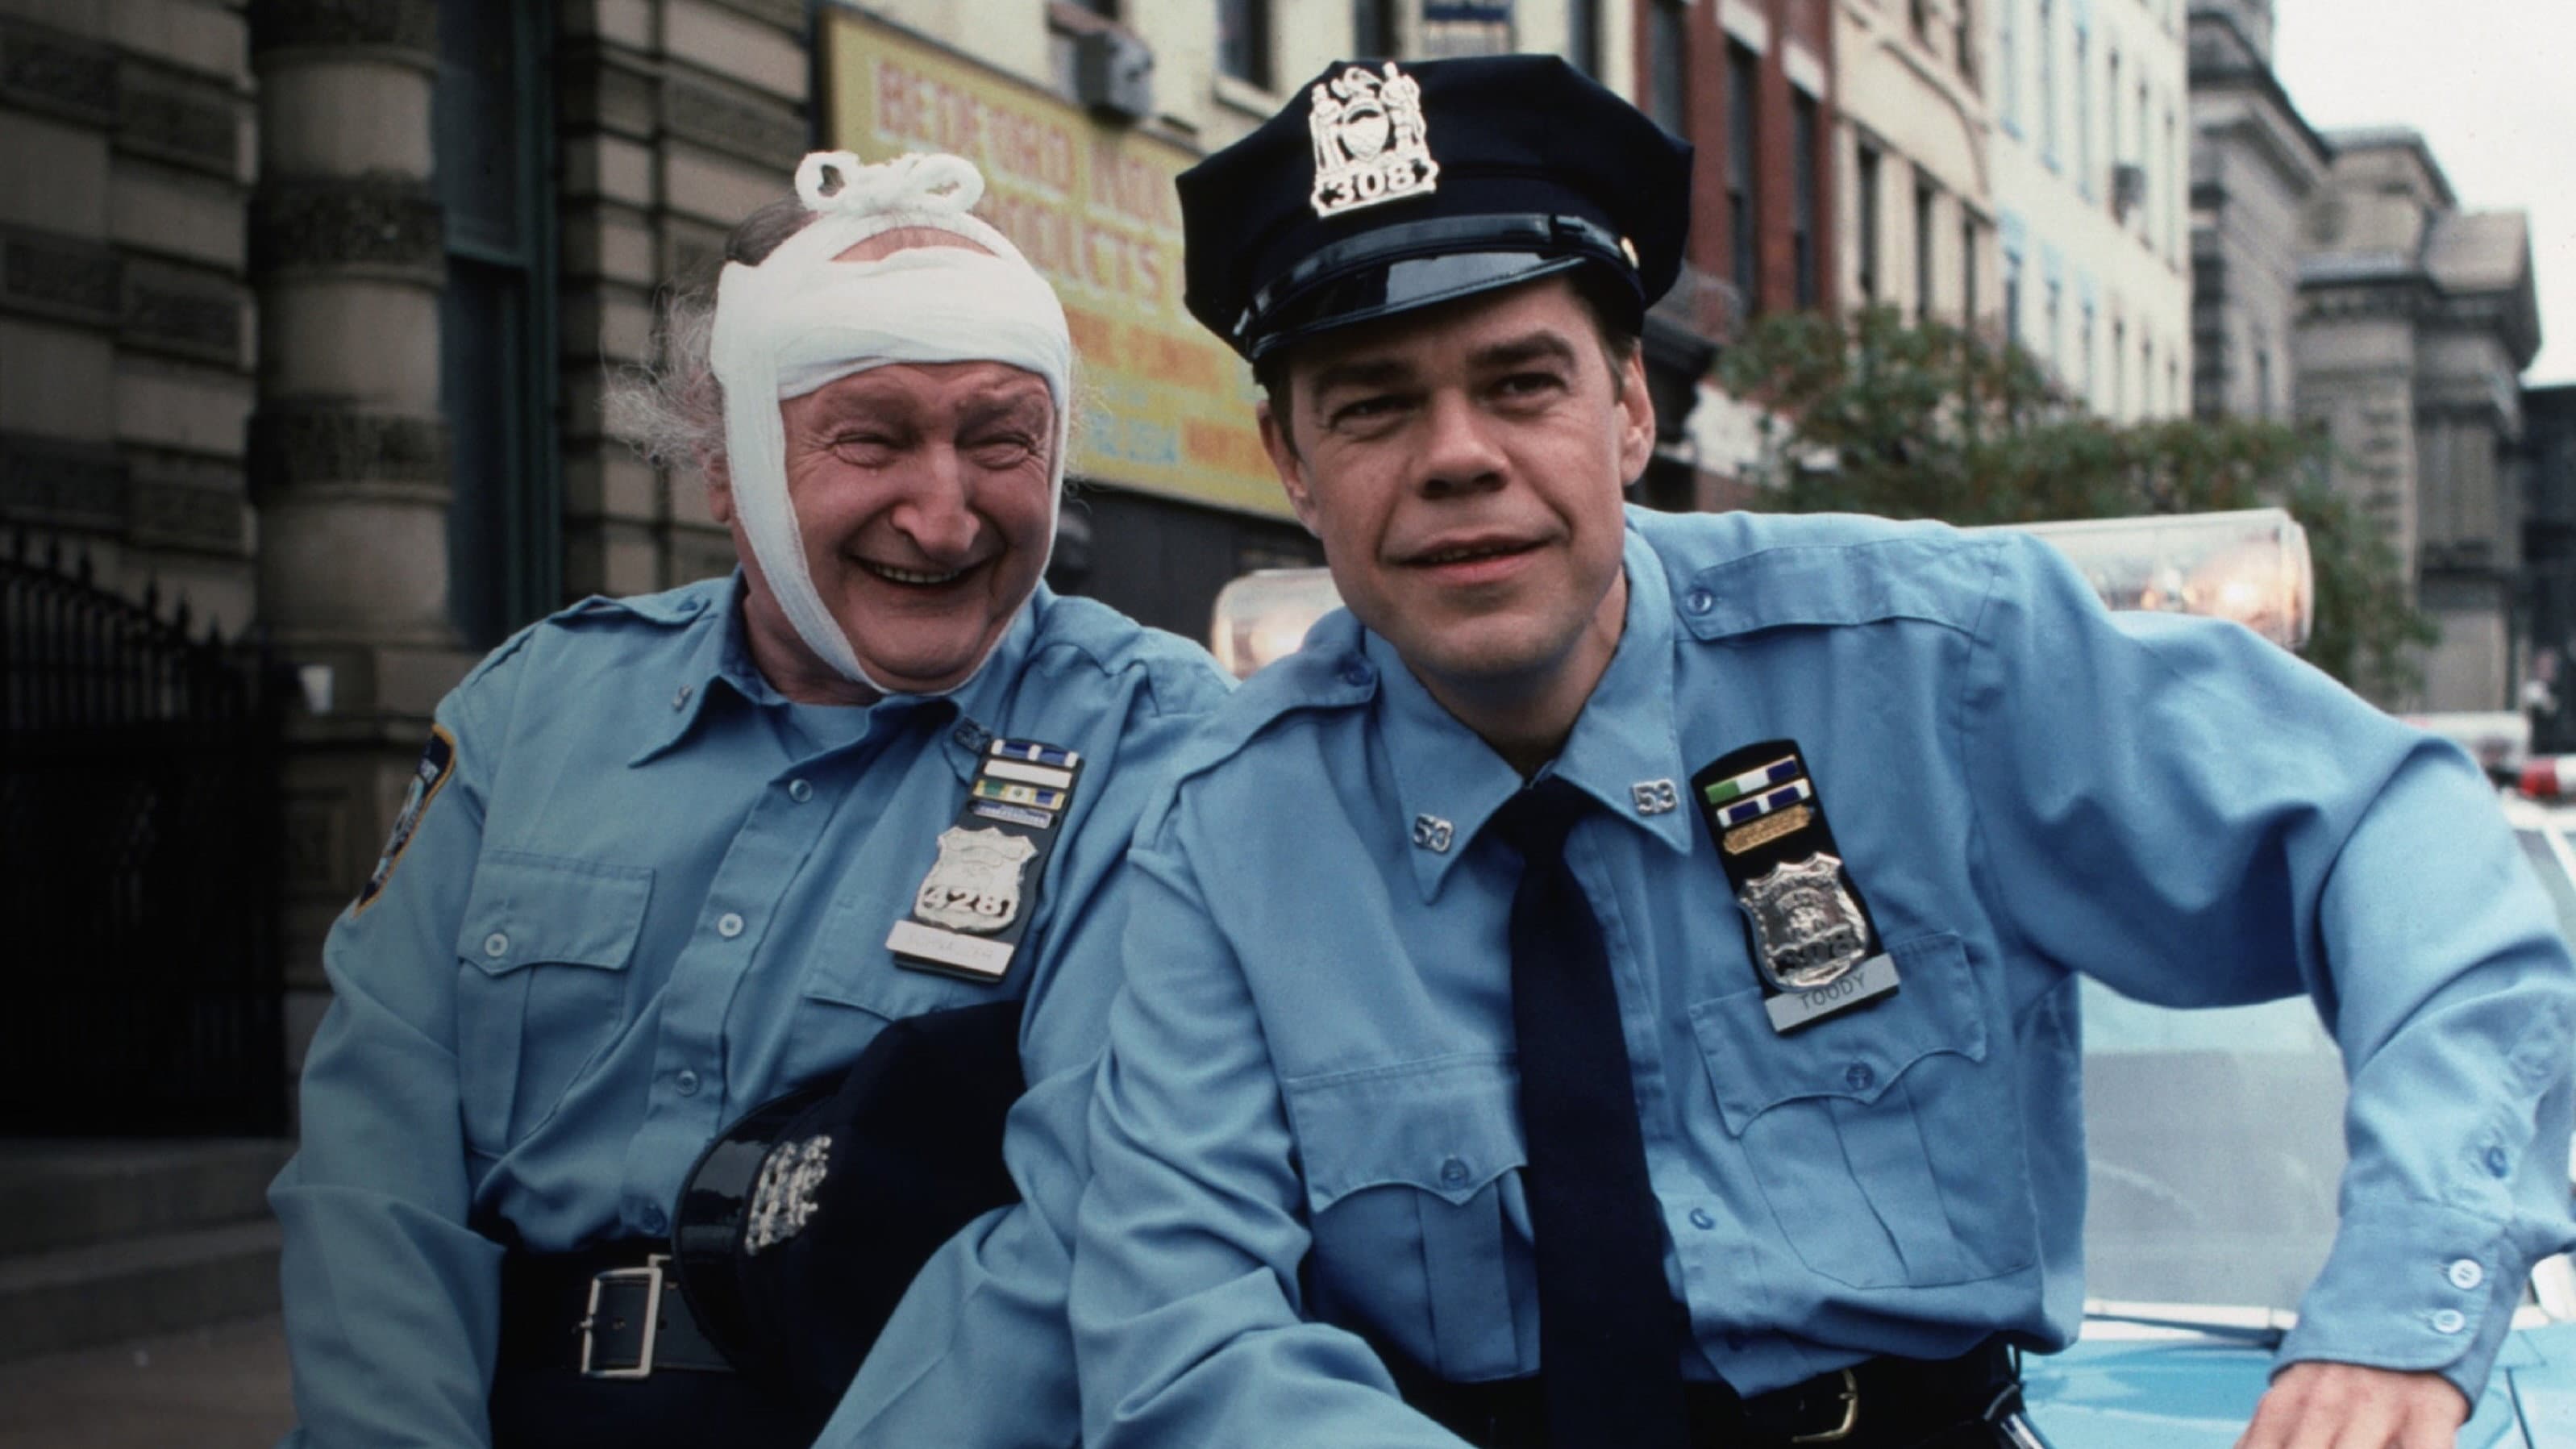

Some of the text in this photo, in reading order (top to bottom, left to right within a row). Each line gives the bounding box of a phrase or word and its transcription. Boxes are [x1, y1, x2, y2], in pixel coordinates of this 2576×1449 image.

[1632, 779, 1677, 814] 53
[1413, 814, 1452, 851] 53
[1799, 972, 1865, 1010] TOODY
